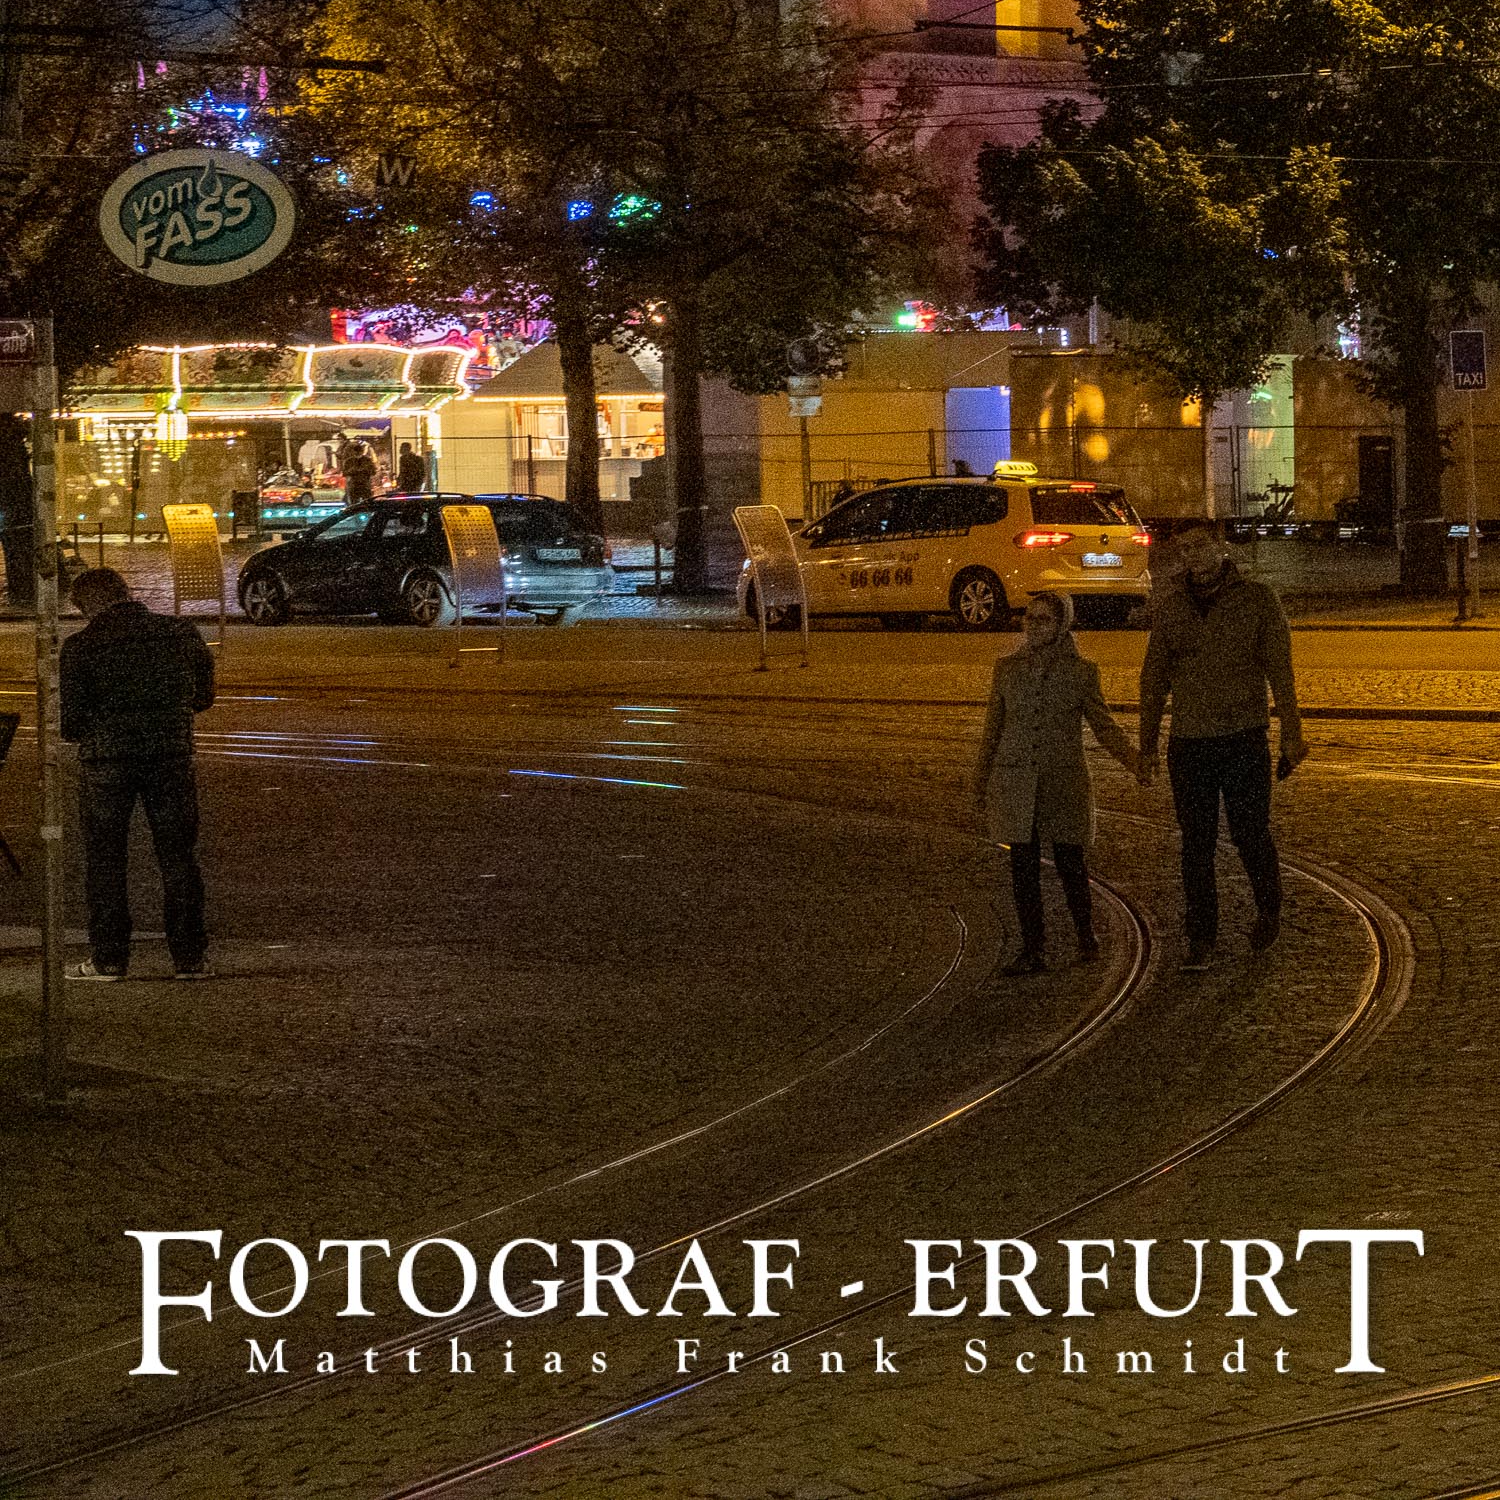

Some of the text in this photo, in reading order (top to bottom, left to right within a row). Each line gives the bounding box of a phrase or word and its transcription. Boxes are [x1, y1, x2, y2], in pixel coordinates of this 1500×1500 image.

[380, 155, 417, 186] W
[132, 177, 194, 222] vom
[135, 181, 253, 268] FASS
[1455, 372, 1484, 387] TAXI
[872, 568, 891, 587] 66
[894, 567, 914, 586] 66
